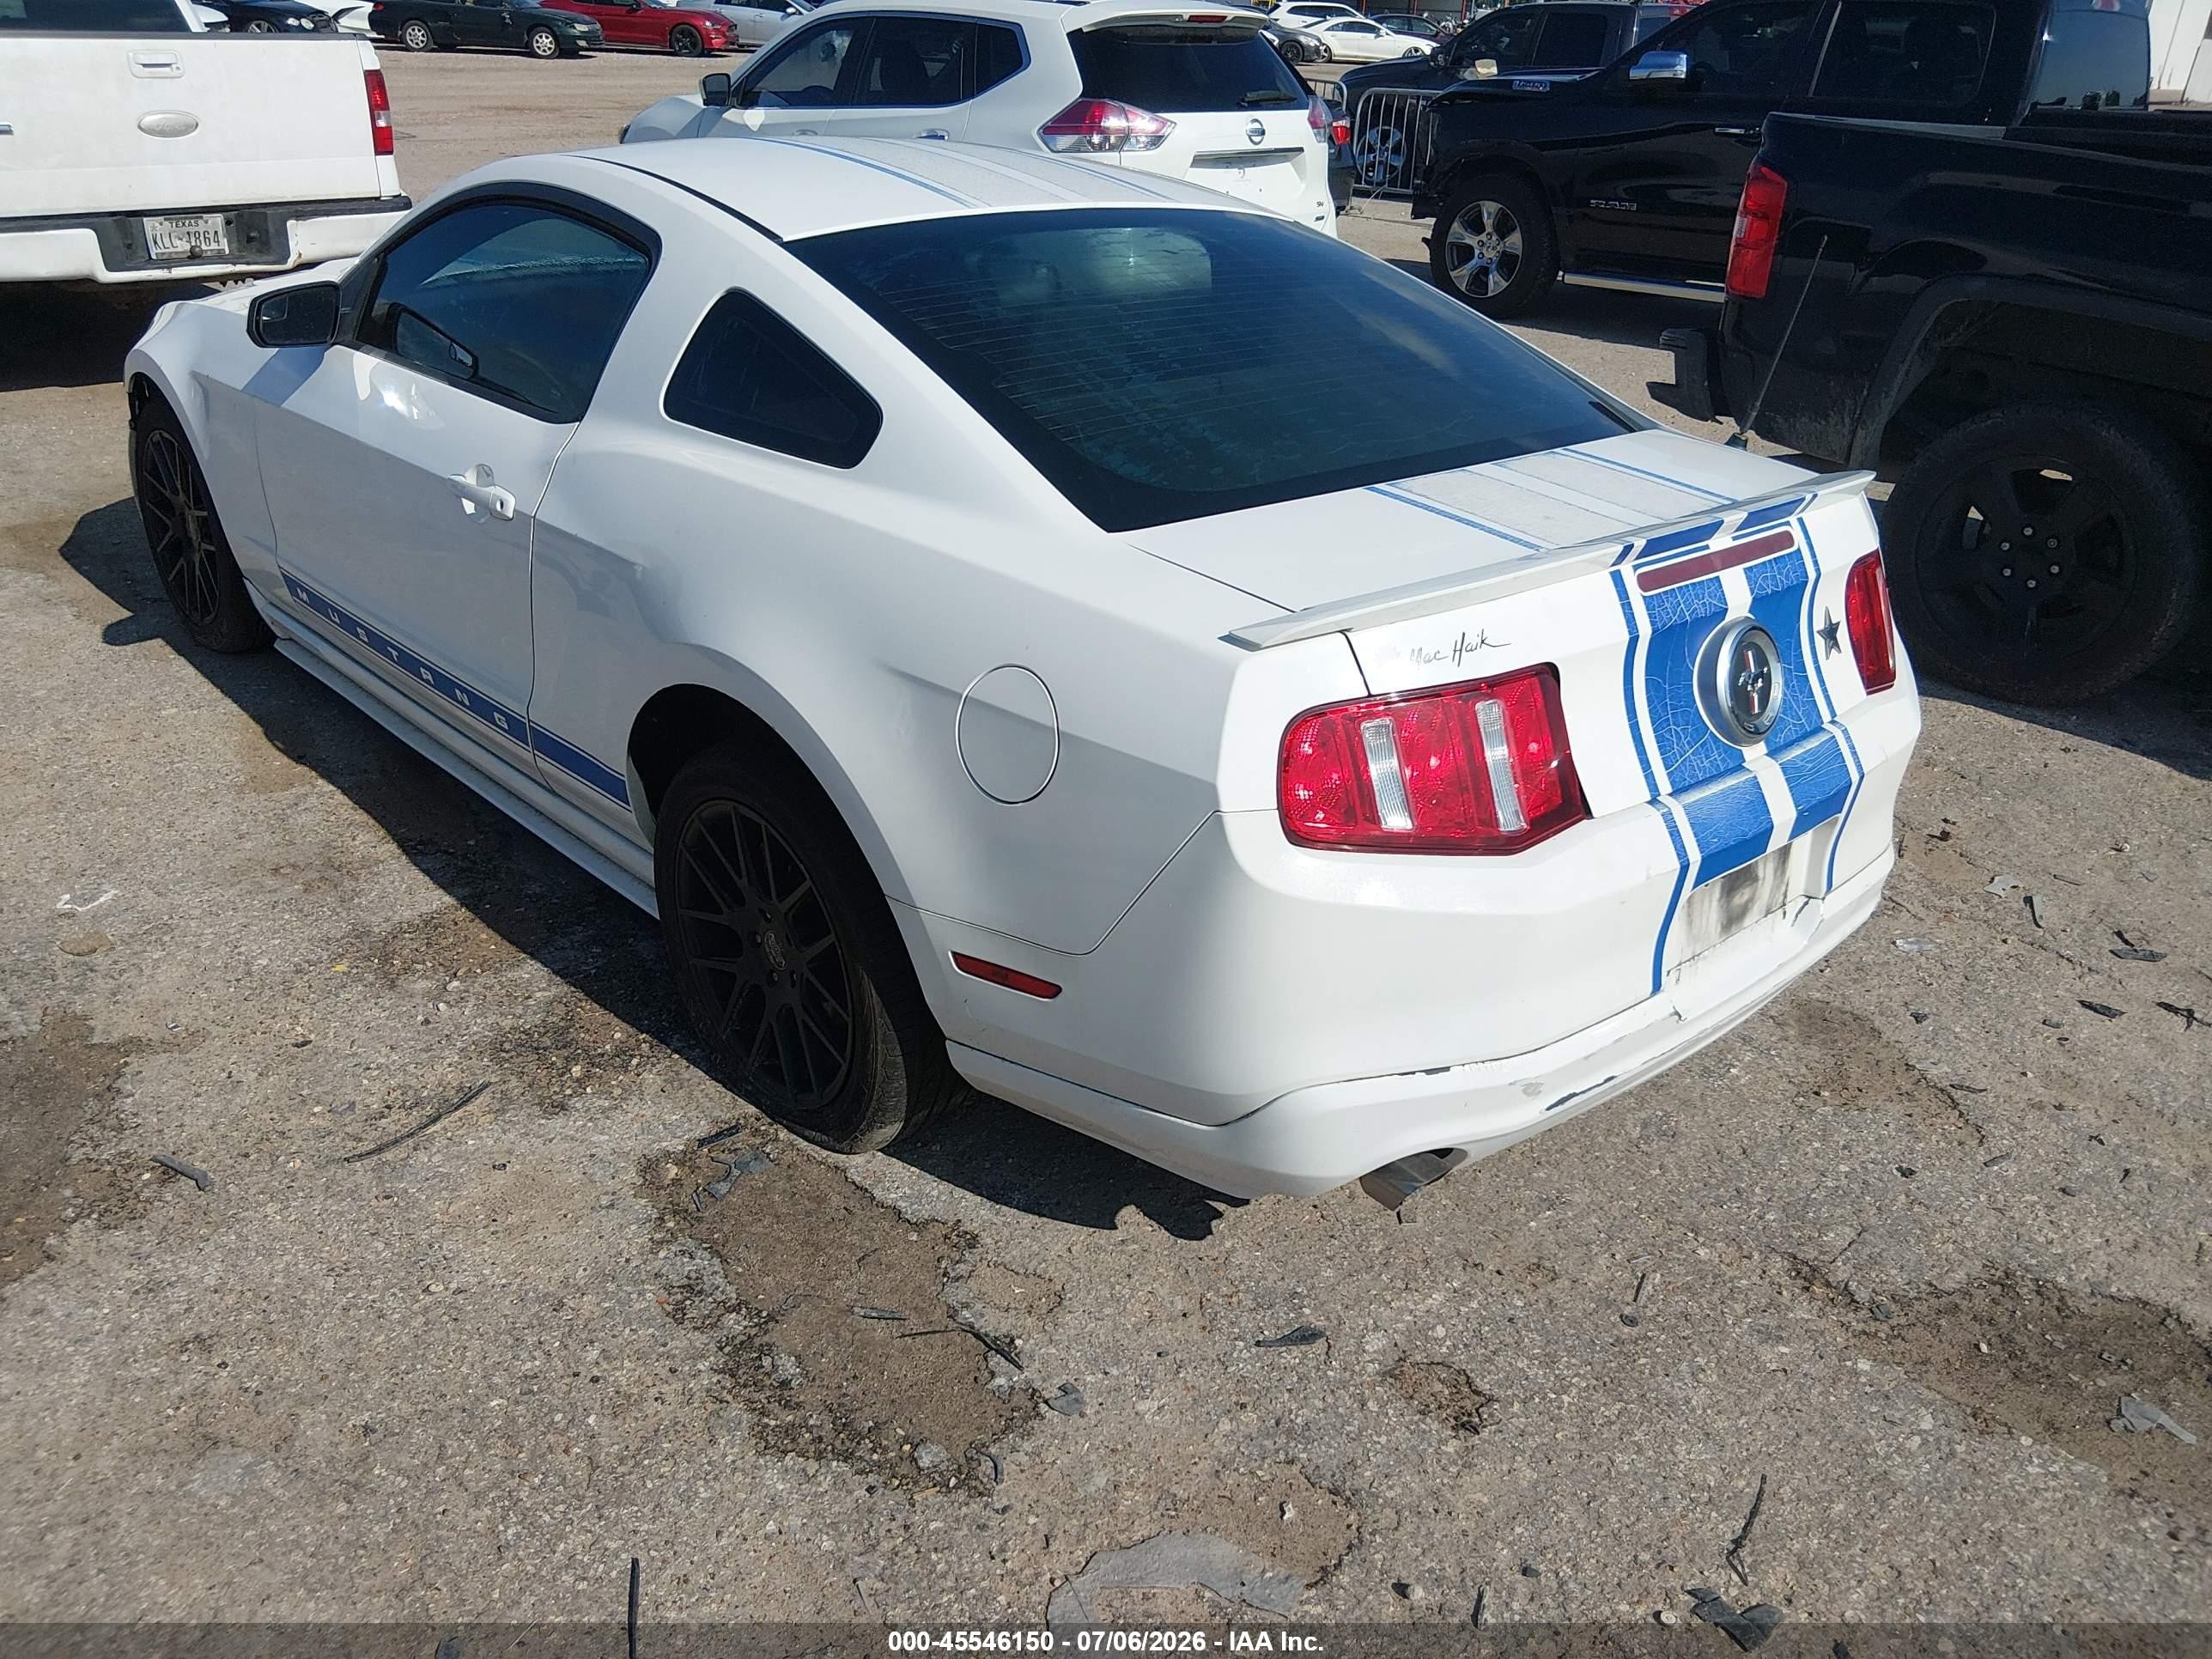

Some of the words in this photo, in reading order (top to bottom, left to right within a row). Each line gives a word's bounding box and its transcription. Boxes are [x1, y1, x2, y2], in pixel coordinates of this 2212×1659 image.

[168, 219, 200, 228] TEXAS
[296, 586, 509, 730] MUSTANG
[1410, 647, 1449, 667] Mac
[1451, 628, 1512, 668] Haik
